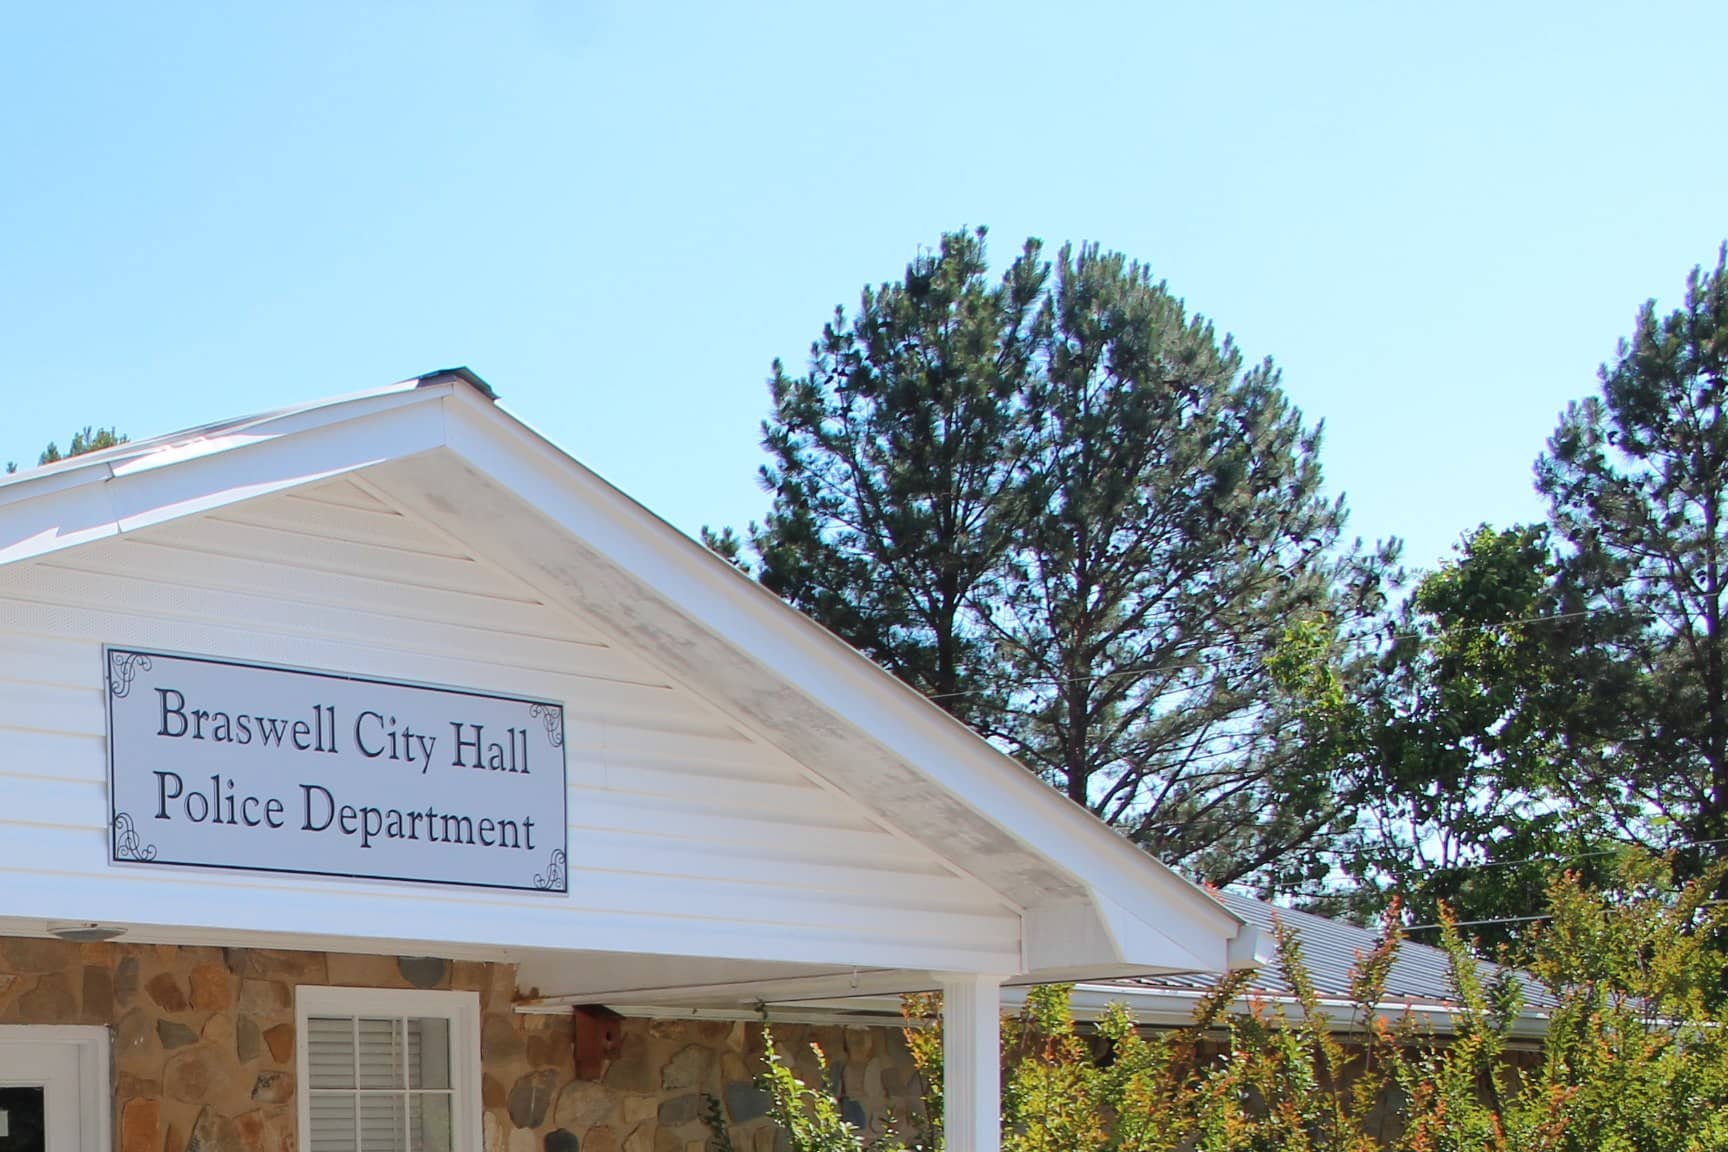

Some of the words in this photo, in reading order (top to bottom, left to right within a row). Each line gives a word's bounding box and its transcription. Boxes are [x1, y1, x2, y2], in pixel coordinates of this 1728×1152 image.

[154, 687, 339, 754] Braswell
[355, 710, 437, 775] City
[449, 721, 531, 775] Hall
[152, 770, 284, 829] Police
[298, 783, 536, 851] Department
